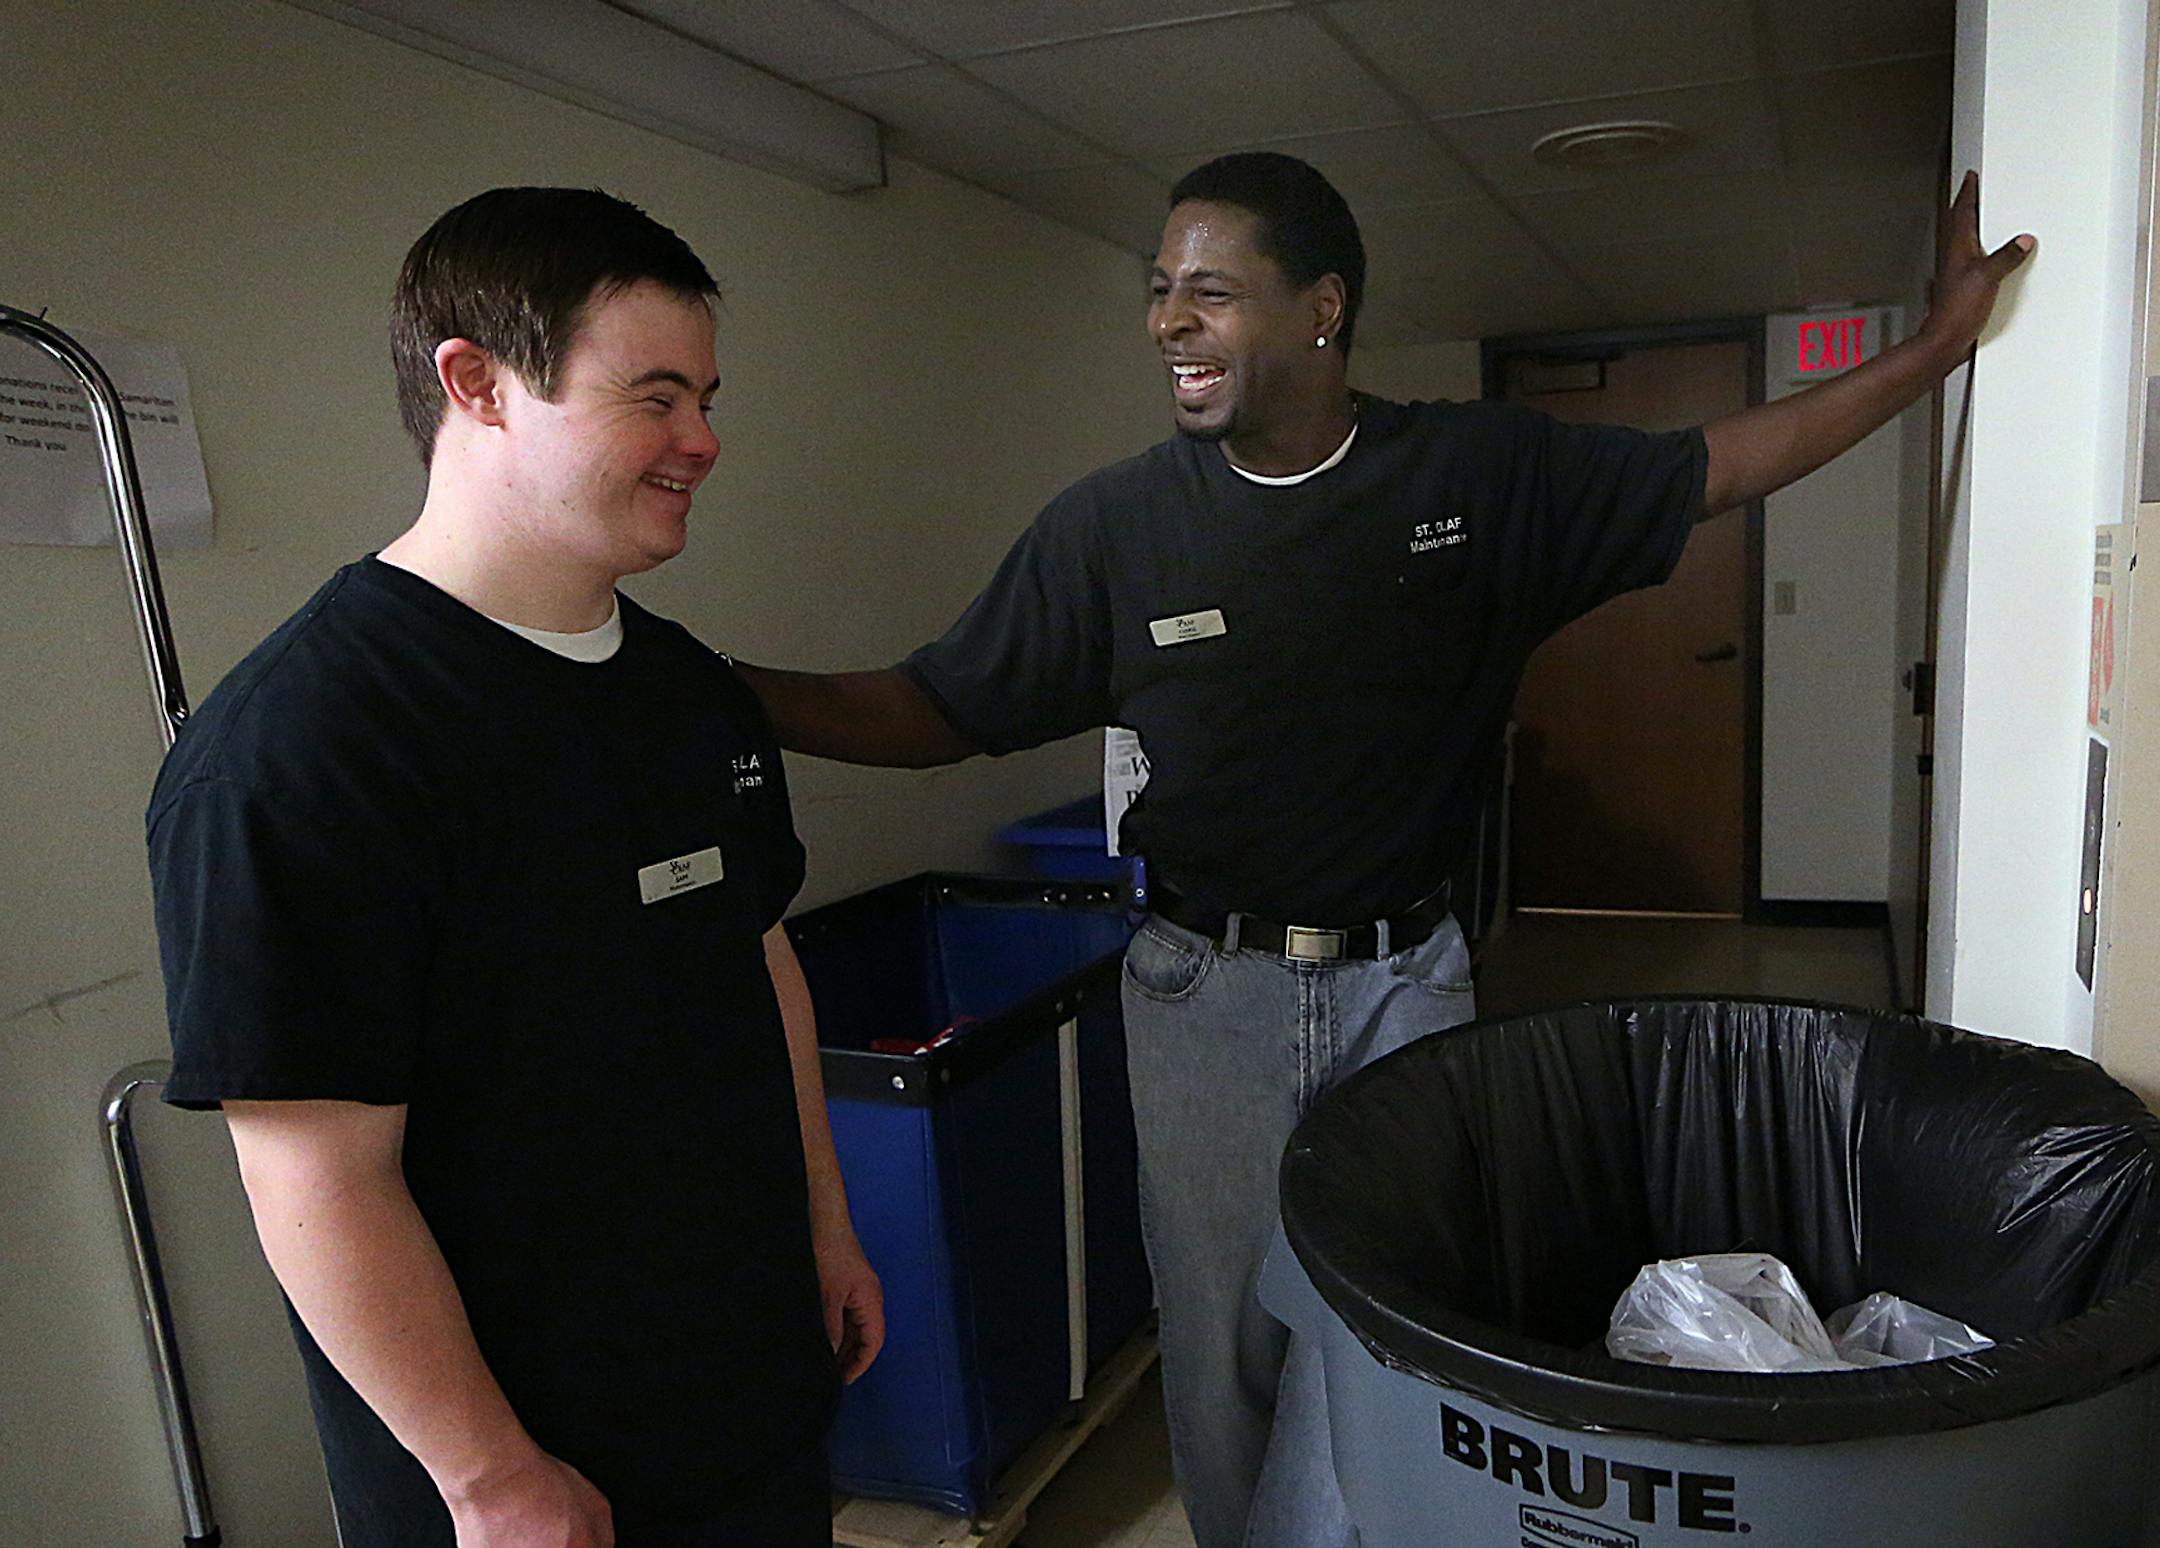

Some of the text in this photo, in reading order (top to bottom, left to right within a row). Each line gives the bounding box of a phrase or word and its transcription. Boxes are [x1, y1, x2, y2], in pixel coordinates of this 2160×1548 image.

[1799, 317, 1867, 371] EXIT
[1415, 523, 1433, 538] ST.
[1440, 1401, 1736, 1533] BRUTE
